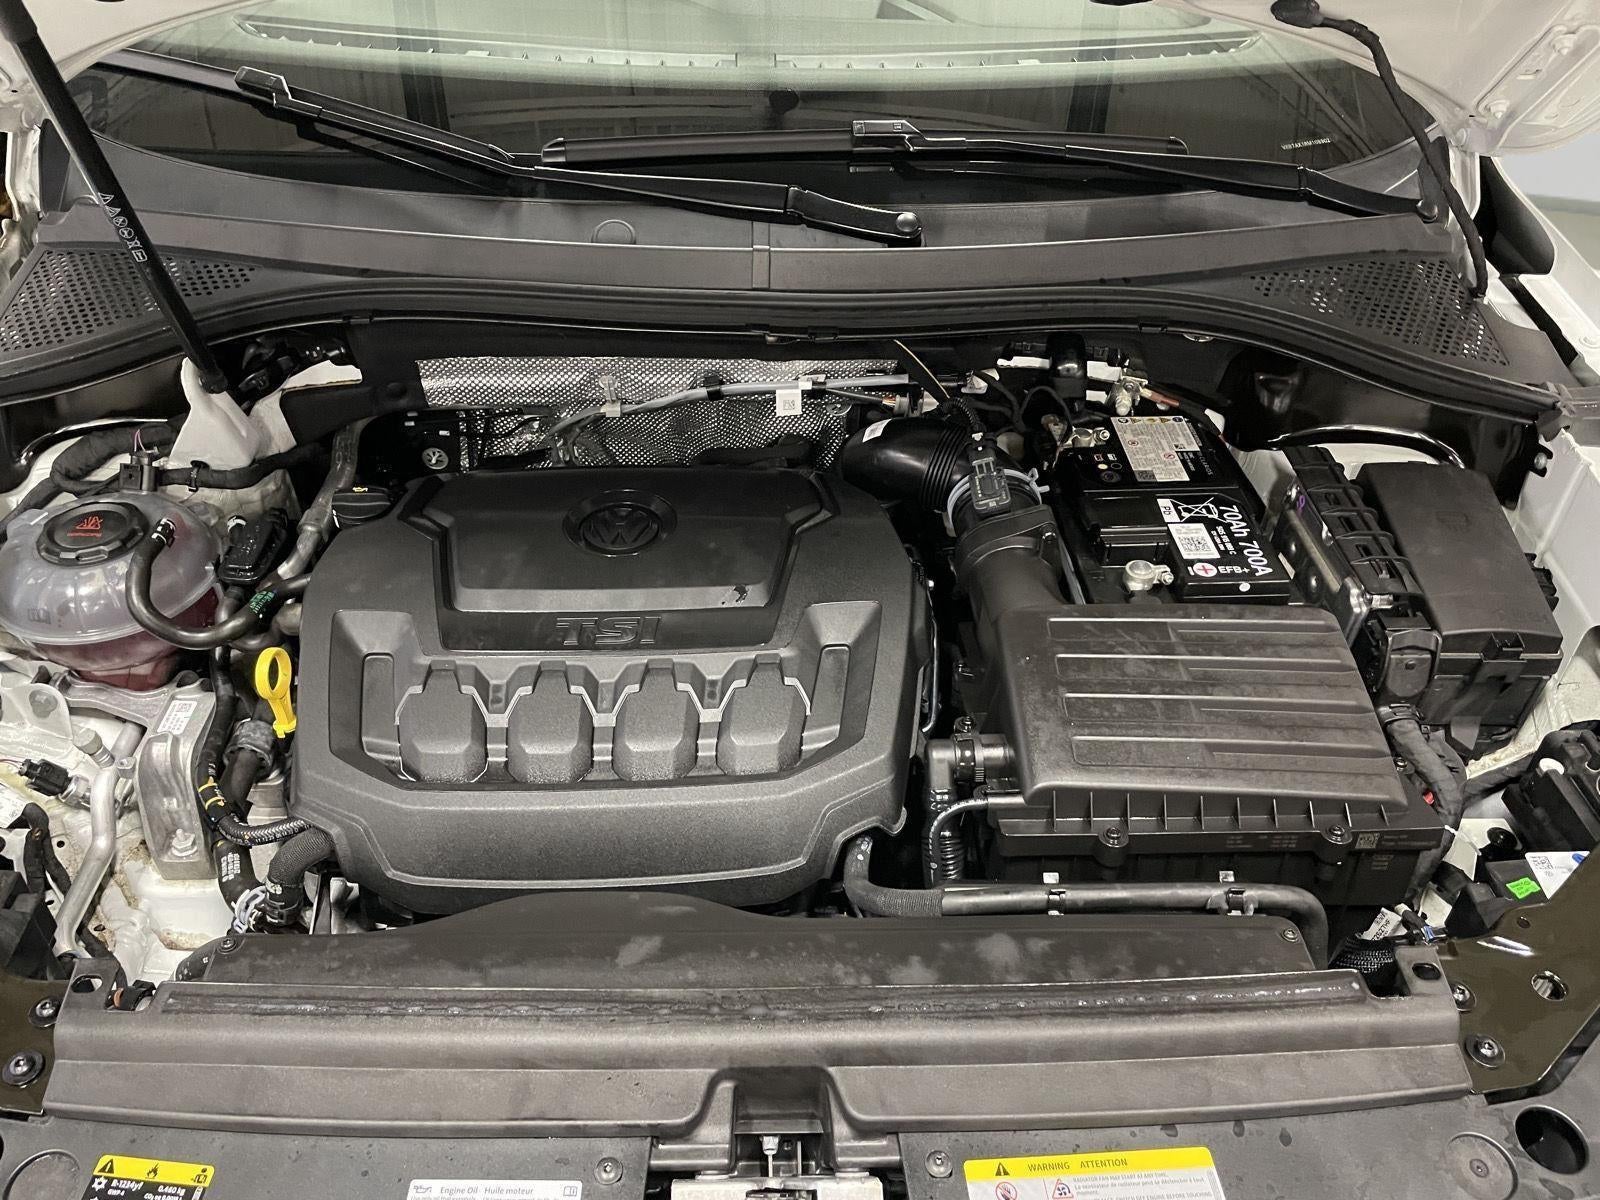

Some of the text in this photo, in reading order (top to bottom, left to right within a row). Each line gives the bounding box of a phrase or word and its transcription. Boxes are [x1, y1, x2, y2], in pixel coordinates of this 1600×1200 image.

[1161, 505, 1172, 516] Pb
[1219, 505, 1273, 576] 70Ah 700A
[1217, 565, 1250, 574] EFB+
[555, 616, 662, 646] TSI
[1028, 1158, 1128, 1172] WARNING ATTENTION
[440, 1185, 534, 1196] Engine Oil Huile moteur
